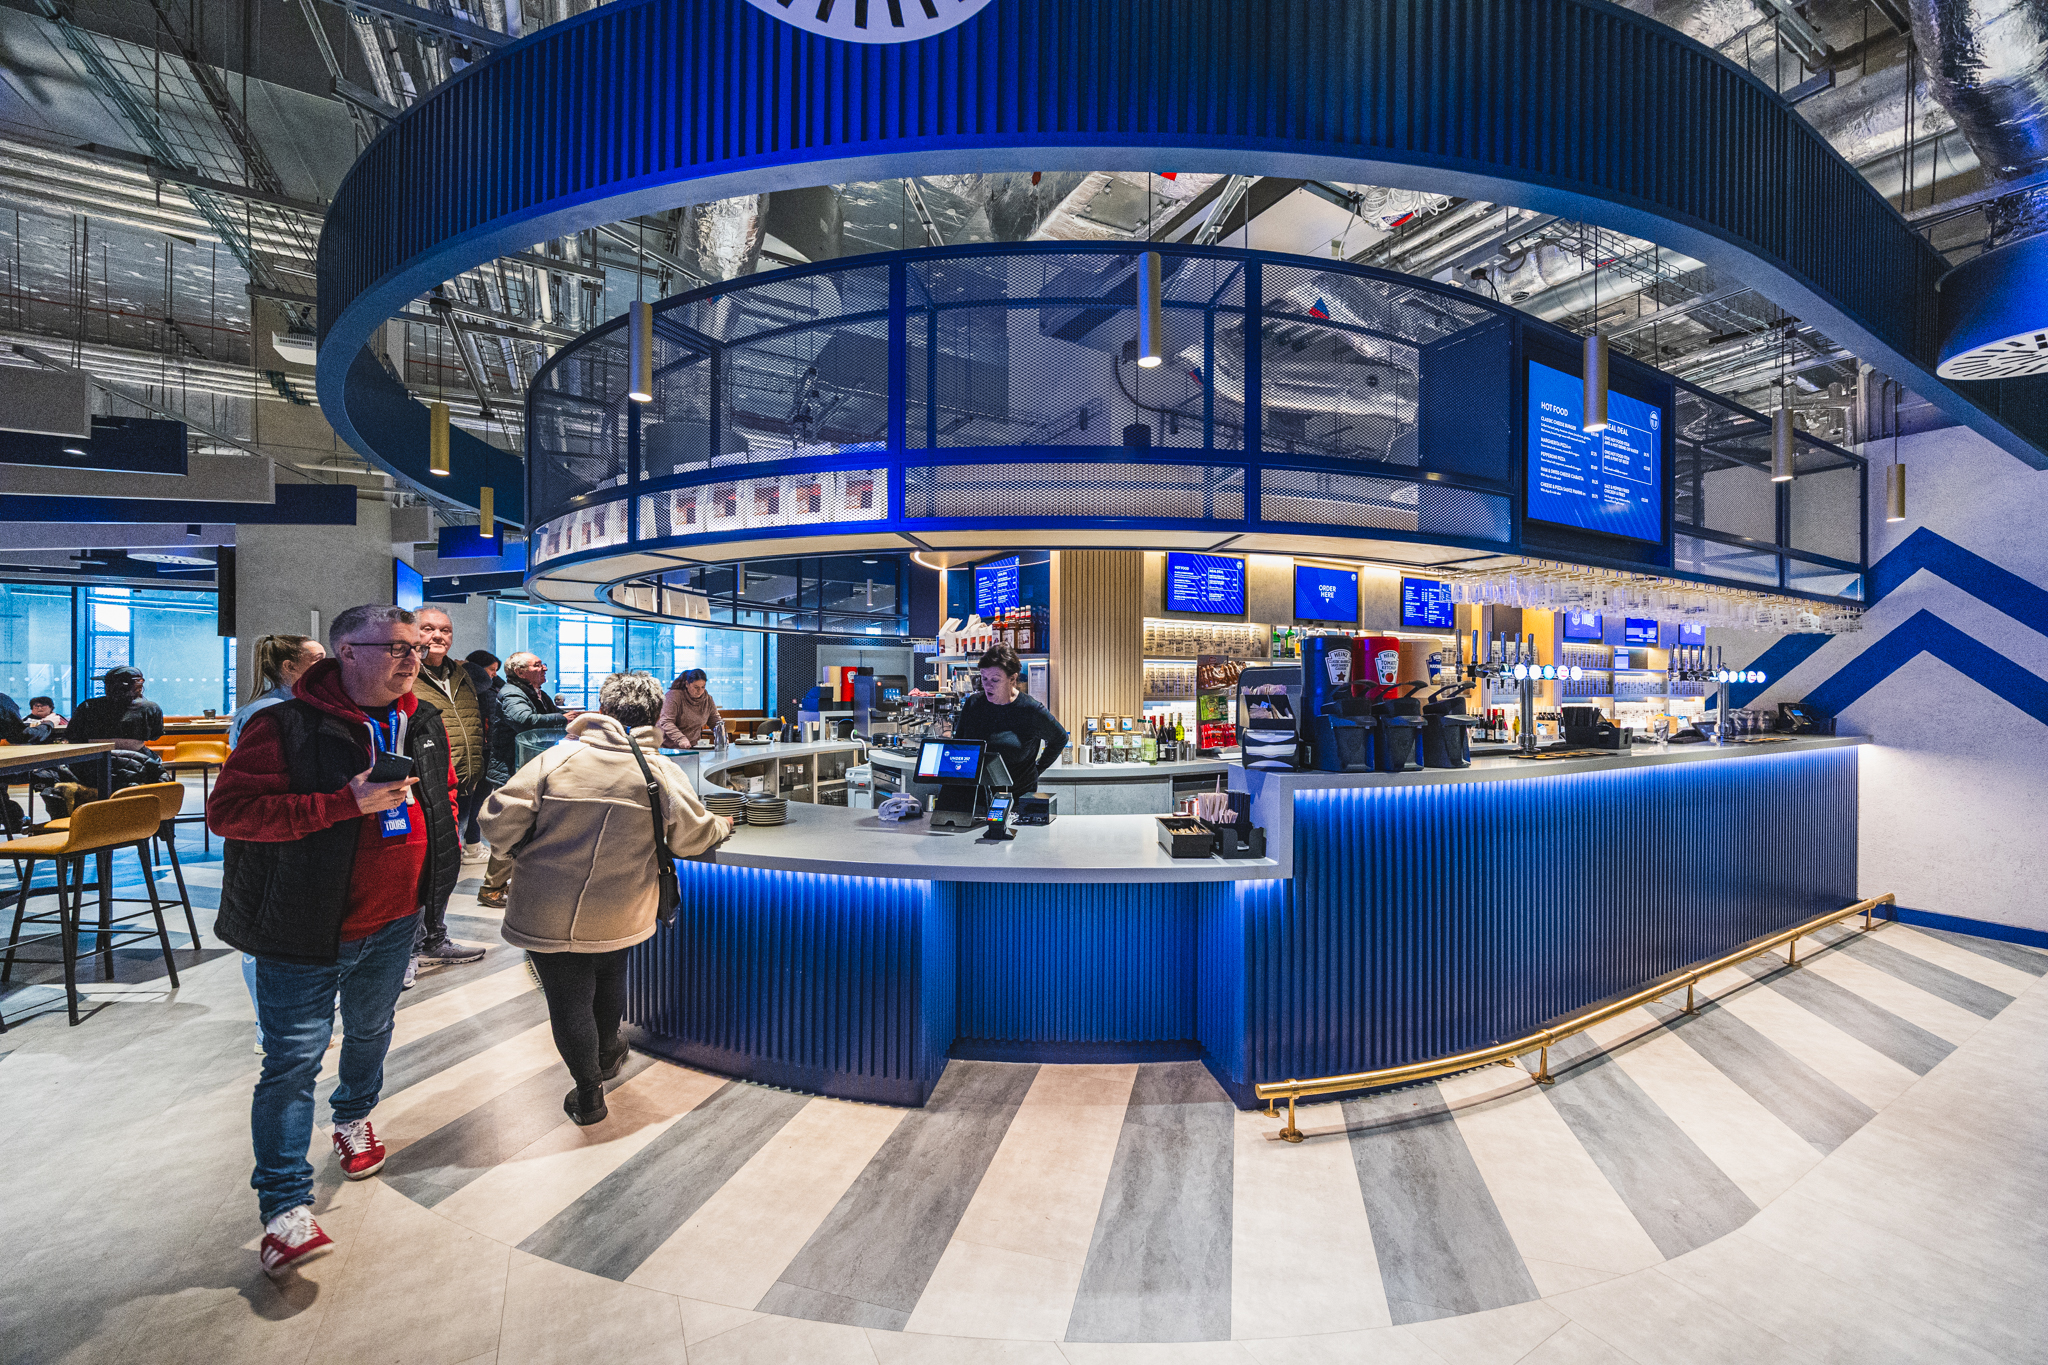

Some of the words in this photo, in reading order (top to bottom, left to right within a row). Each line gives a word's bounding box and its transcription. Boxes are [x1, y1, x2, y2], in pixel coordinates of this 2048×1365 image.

[1541, 401, 1553, 411] HOT
[1553, 405, 1569, 416] FOOD
[1565, 423, 1577, 431] BURGER
[1617, 426, 1629, 436] DEAL
[1318, 584, 1337, 592] ORDER
[1320, 591, 1335, 599] HERE
[383, 817, 407, 831] TOURS
